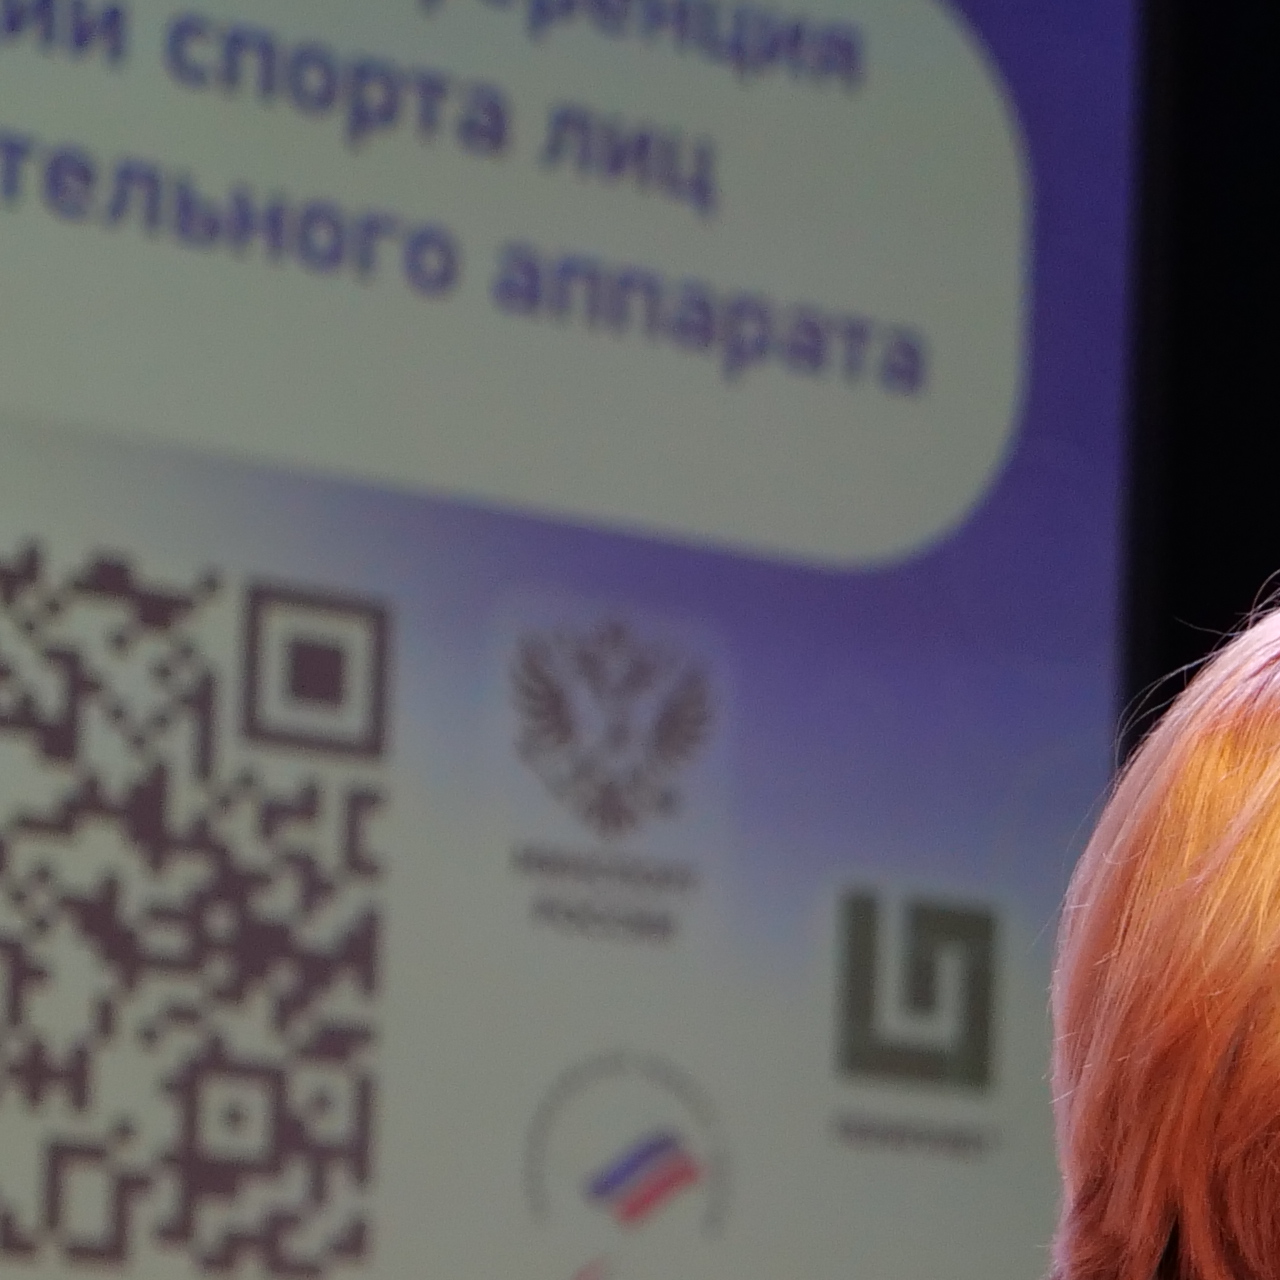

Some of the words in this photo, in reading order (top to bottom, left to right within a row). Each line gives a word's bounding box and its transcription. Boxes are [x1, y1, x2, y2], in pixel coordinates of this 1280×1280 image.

[162, 10, 512, 153] спорта
[537, 100, 720, 218] лиц
[490, 240, 930, 398] аппарата
